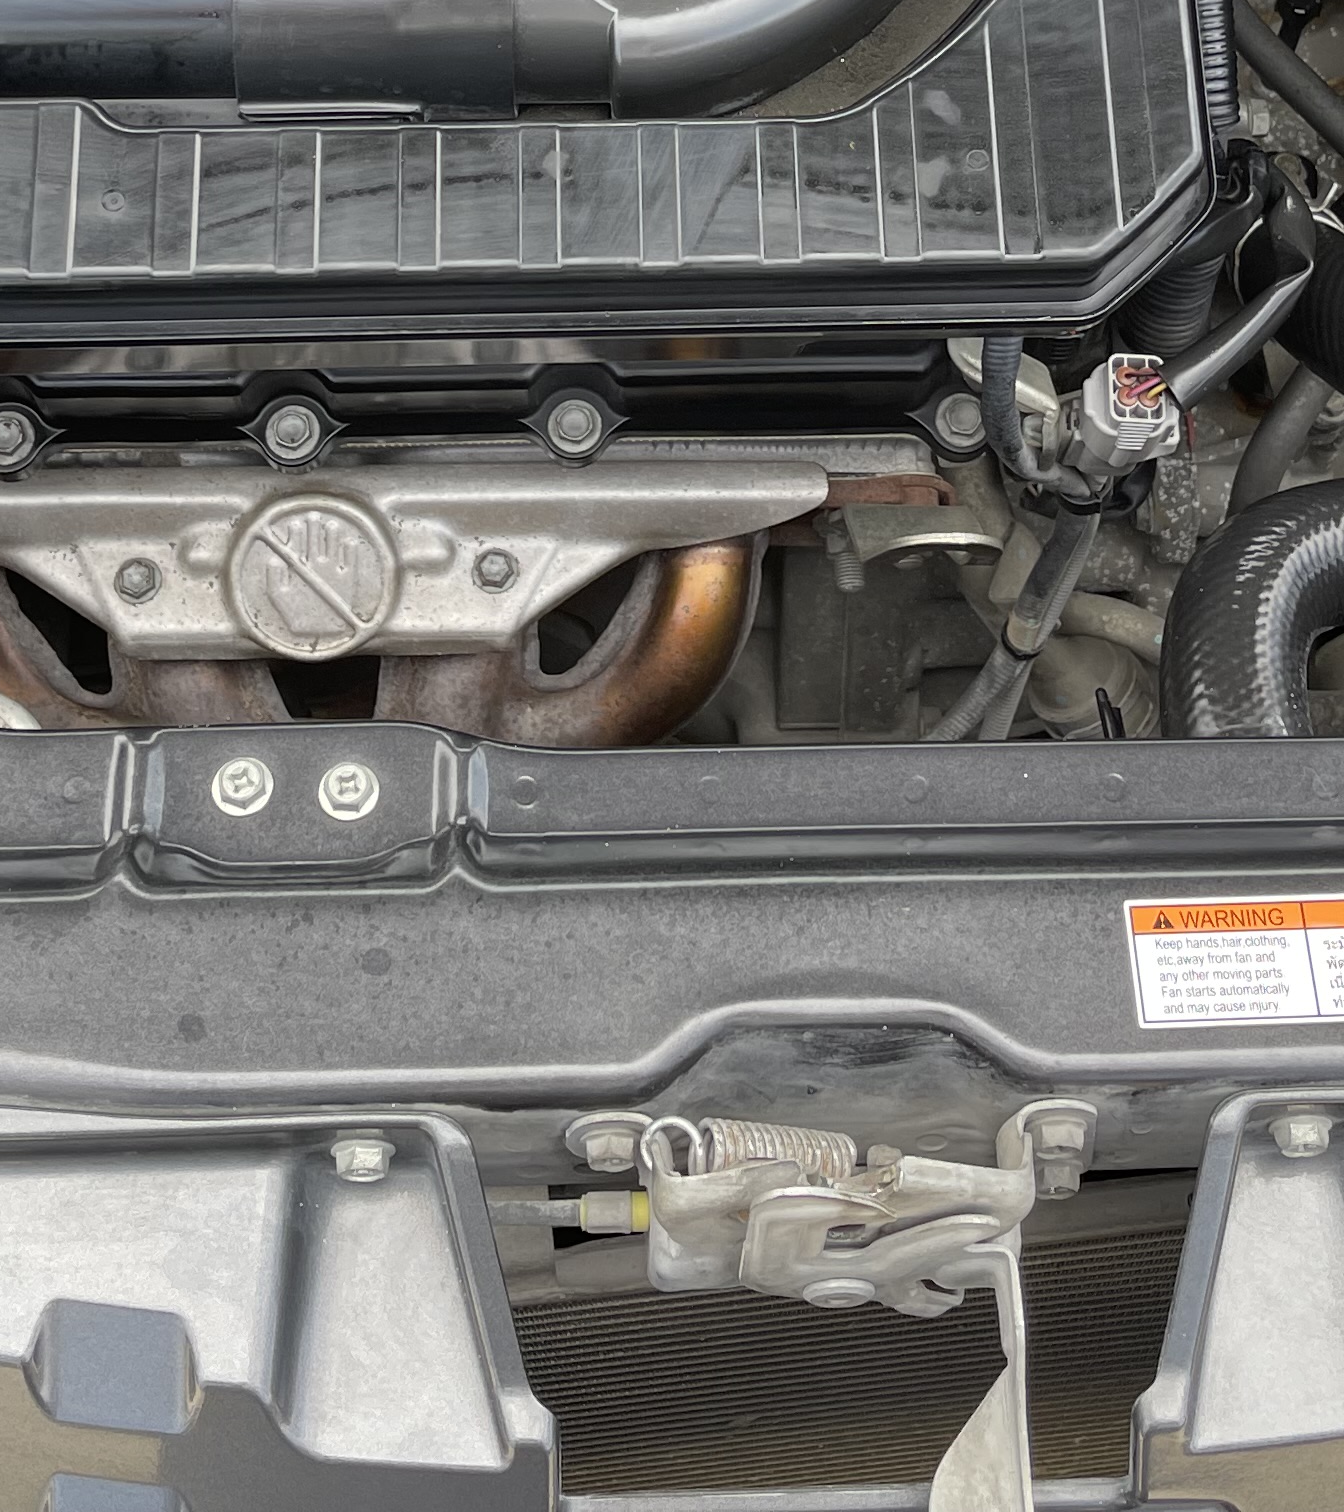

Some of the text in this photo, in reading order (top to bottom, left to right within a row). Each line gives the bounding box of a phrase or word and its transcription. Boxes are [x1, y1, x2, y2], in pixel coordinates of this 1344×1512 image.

[1179, 908, 1285, 928] WARNING
[1155, 938, 1183, 952] Keep
[1208, 952, 1232, 964] from
[1234, 951, 1252, 963] fan
[1256, 951, 1275, 963] and
[1160, 971, 1178, 984] any
[1182, 968, 1209, 981] other
[1213, 968, 1252, 982] moving
[1161, 982, 1289, 998] Fan starts automatically
[1164, 1002, 1184, 1014] and
[1187, 1002, 1209, 1015] may
[1214, 1001, 1245, 1013] cause
